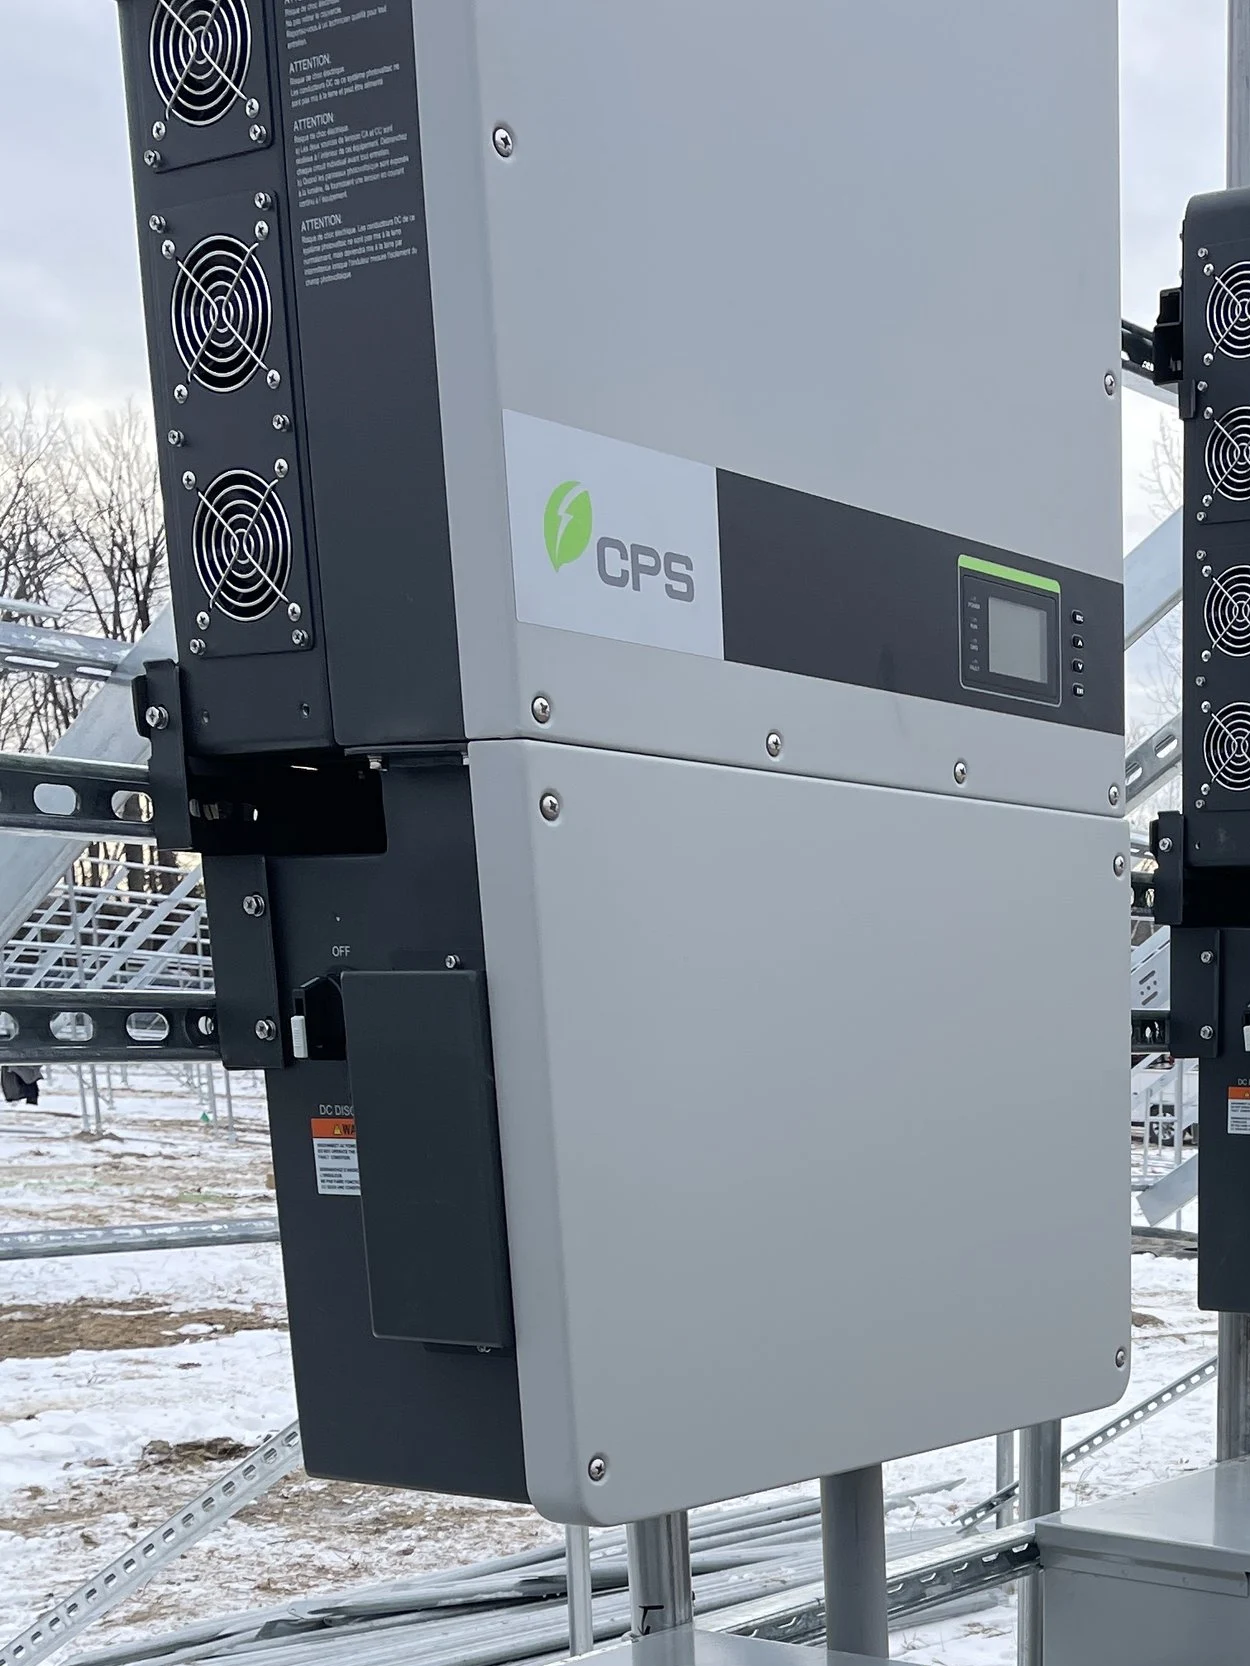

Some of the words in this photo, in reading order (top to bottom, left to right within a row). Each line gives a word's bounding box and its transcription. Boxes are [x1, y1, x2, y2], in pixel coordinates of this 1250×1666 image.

[597, 536, 695, 603] CPS
[331, 945, 351, 957] OFF
[319, 1104, 333, 1116] DC
